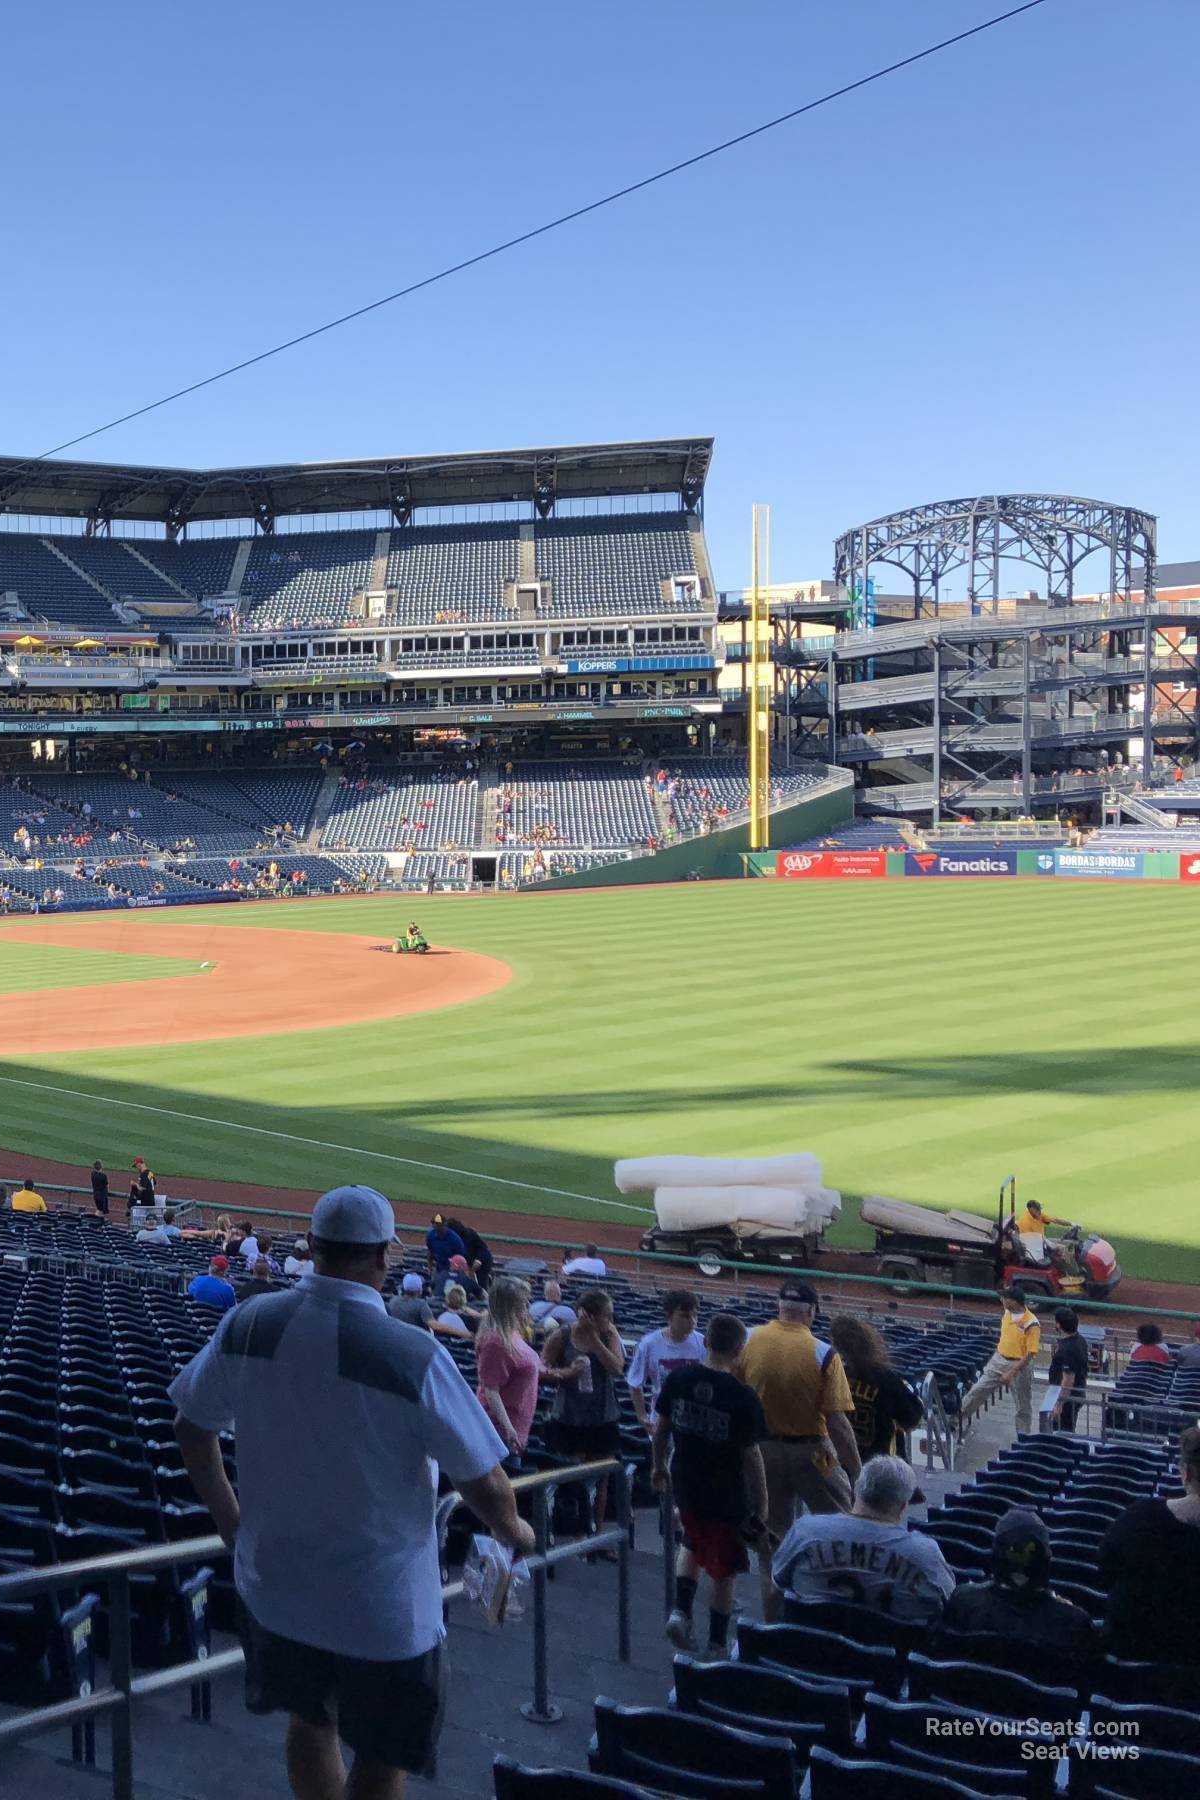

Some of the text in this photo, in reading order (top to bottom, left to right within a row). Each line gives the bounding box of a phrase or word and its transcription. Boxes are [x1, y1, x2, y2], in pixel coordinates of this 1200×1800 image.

[578, 661, 617, 671] KOPPERS
[256, 721, 274, 729] 8:15
[786, 857, 810, 867] AAA
[940, 858, 1008, 872] Fanatics
[1059, 855, 1095, 866] BORDAS
[1098, 855, 1136, 867] BORDAS
